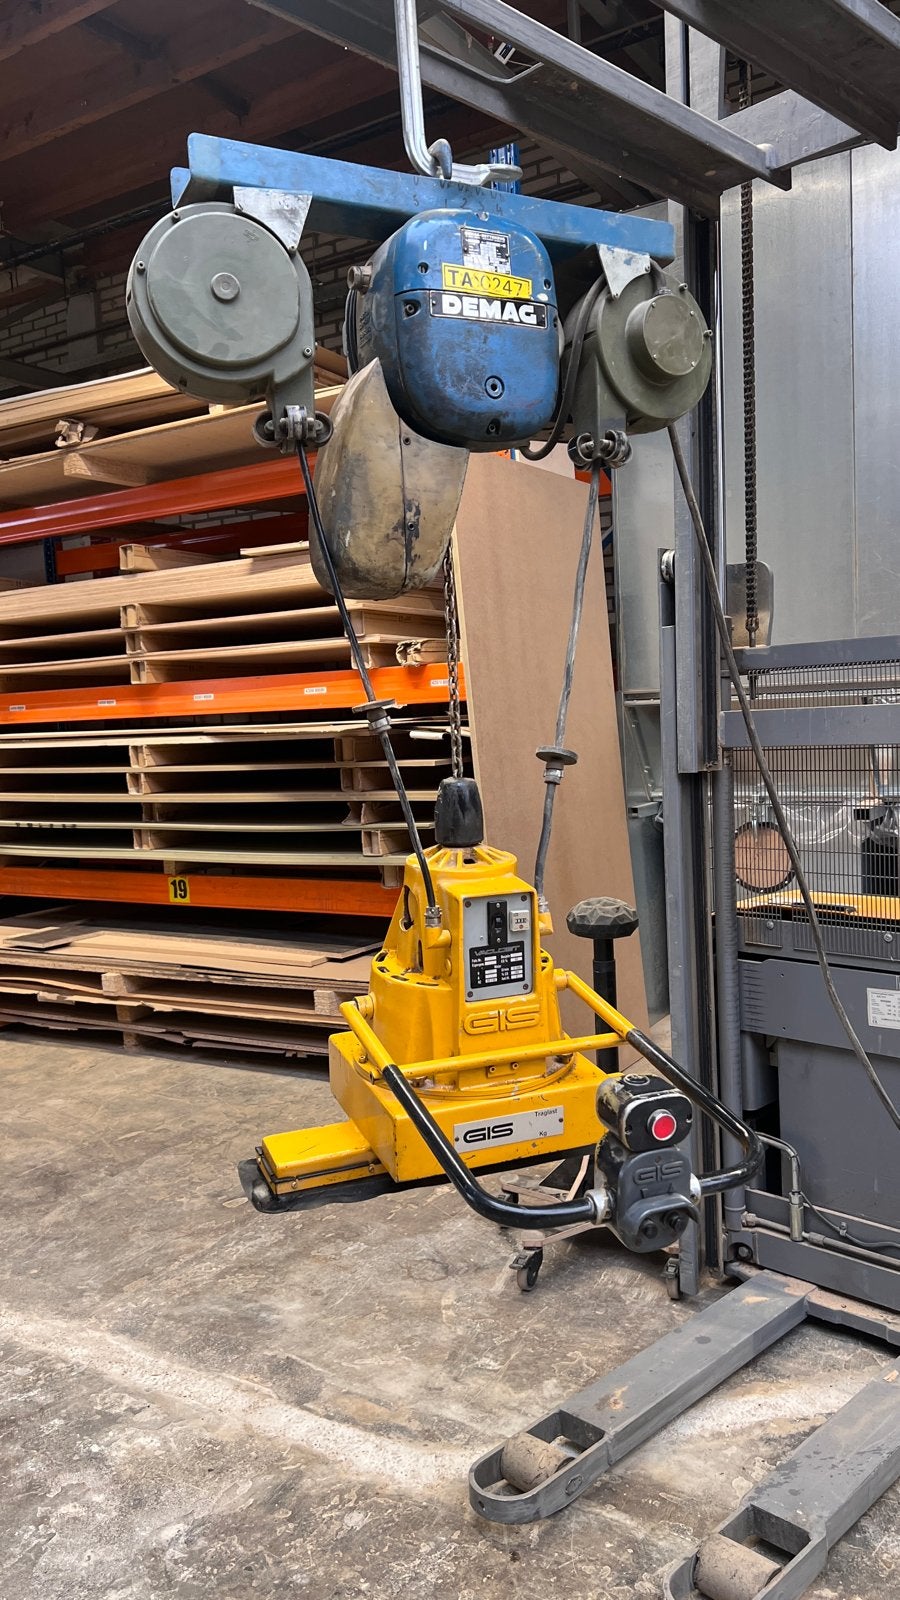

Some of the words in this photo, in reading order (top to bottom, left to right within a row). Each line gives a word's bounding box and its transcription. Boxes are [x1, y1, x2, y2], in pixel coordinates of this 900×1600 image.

[441, 294, 538, 325] DEMAG
[170, 879, 188, 900] 19
[463, 1004, 541, 1035] GIS
[535, 1108, 558, 1117] Traglast
[463, 1122, 514, 1143] GIS
[539, 1130, 548, 1138] Kg
[631, 1160, 684, 1186] GIS
